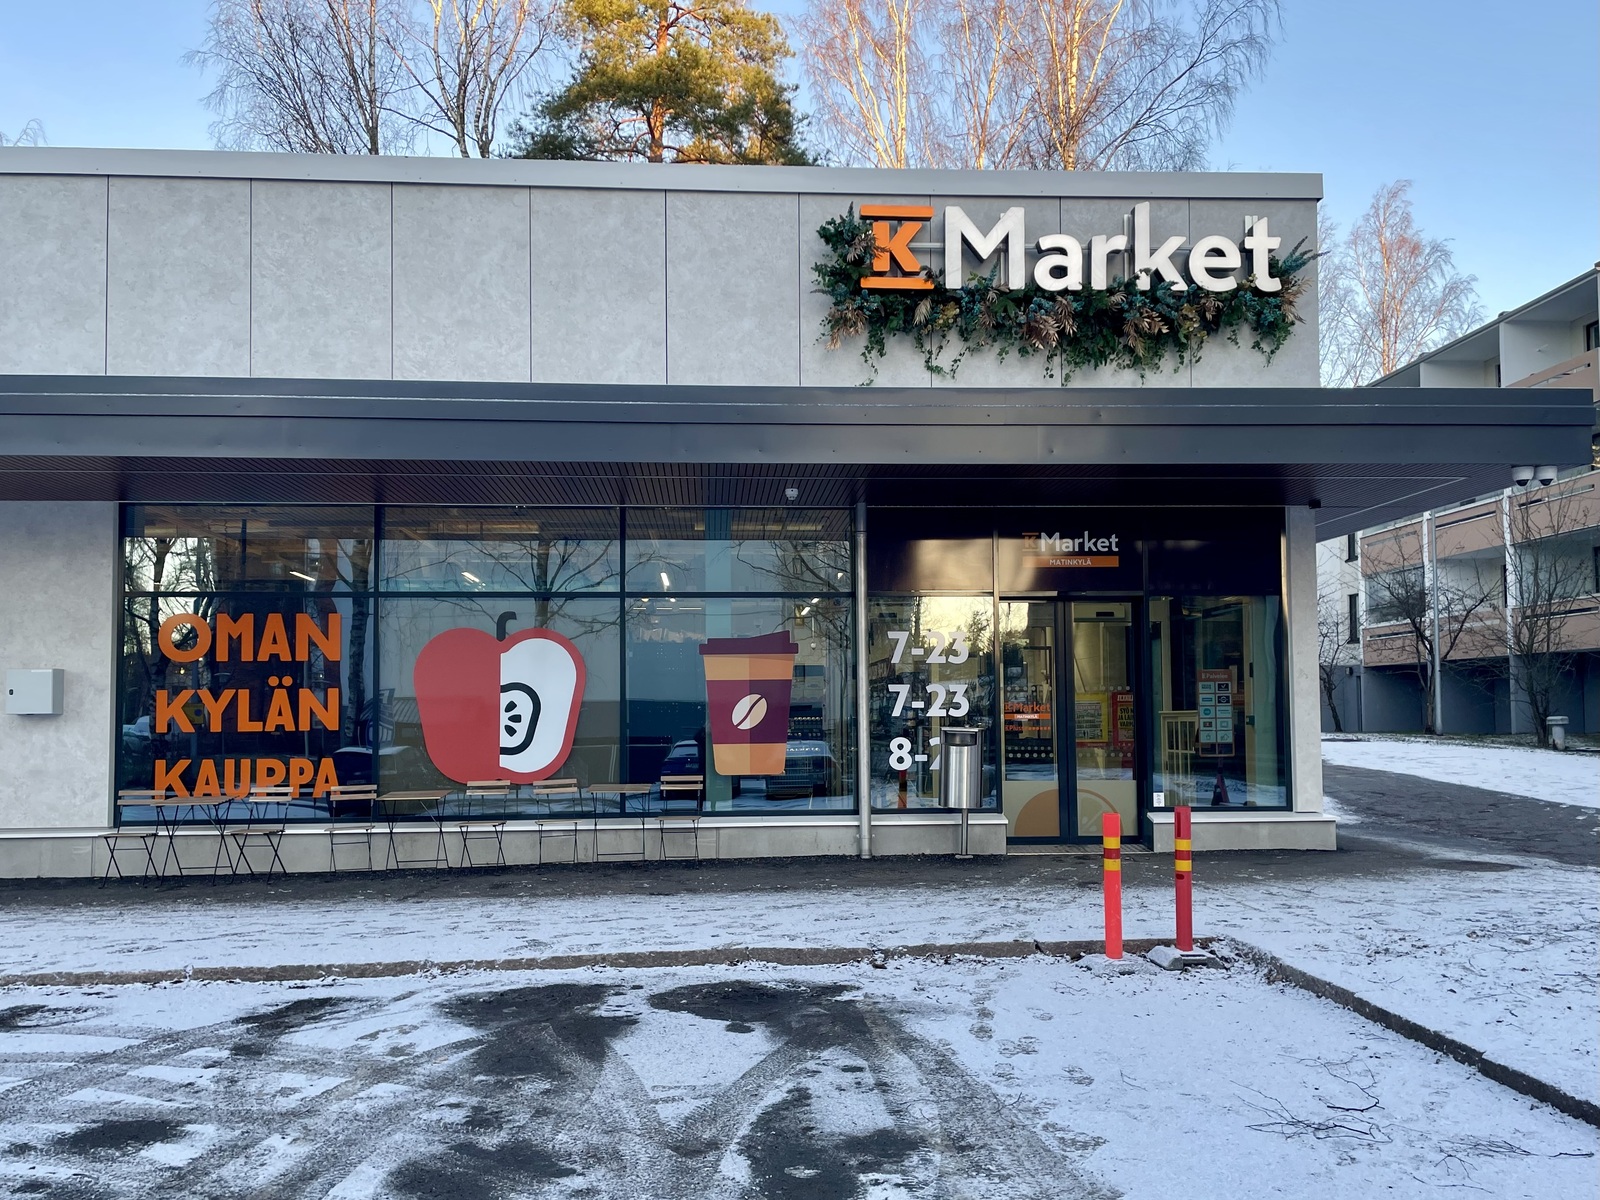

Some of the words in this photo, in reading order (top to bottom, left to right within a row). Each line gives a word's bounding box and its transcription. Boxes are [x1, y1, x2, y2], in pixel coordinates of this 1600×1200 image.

[944, 202, 1282, 292] Market
[1040, 530, 1119, 552] Market
[1049, 558, 1092, 566] MATINKYLÄ
[158, 613, 342, 662] OMAN
[887, 631, 969, 664] 7-23
[155, 675, 339, 733] KYLÄN
[888, 684, 970, 717] 7-23
[1012, 701, 1051, 712] Market
[154, 757, 341, 800] KAUPPA
